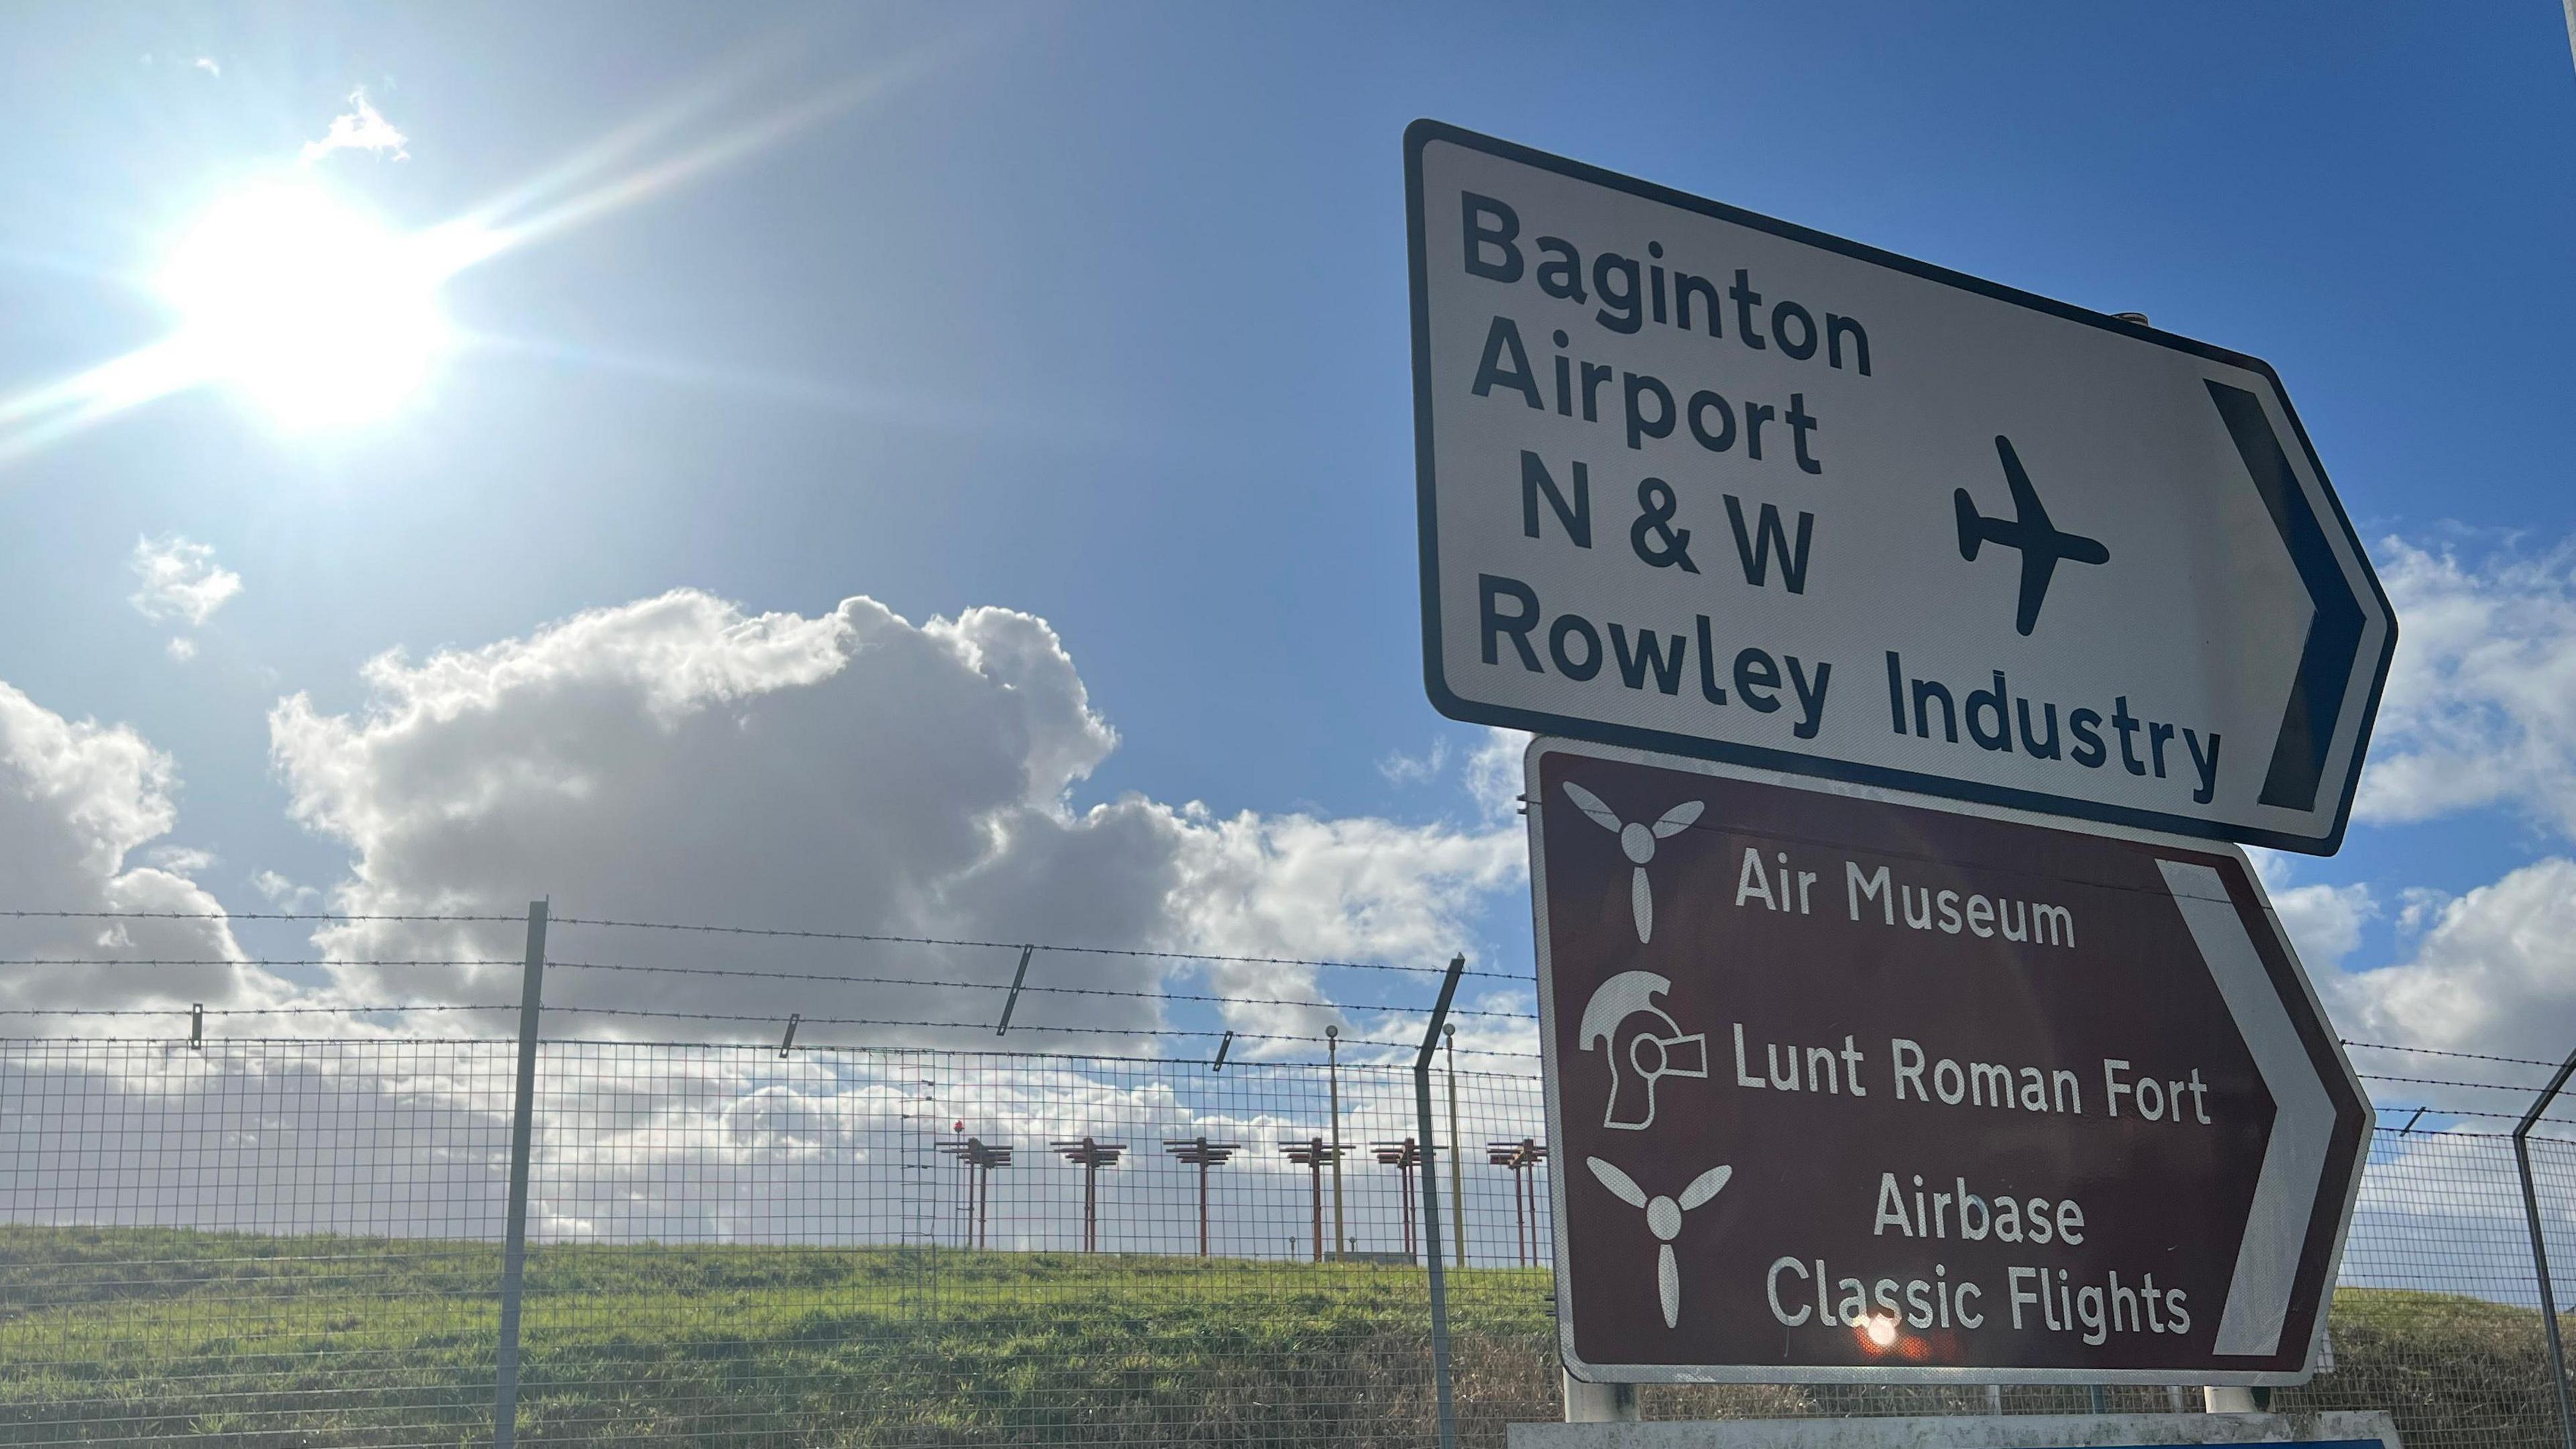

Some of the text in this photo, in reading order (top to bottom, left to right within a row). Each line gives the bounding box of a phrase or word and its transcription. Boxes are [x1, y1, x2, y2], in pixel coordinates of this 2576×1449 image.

[1461, 191, 1872, 376] Baginton
[1471, 315, 1822, 474] Airport
[1520, 449, 1814, 595] N & W
[1479, 573, 2221, 804] Rowley Industry
[1735, 847, 2076, 949] Air Museum
[1733, 1022, 2211, 1125] Lunt Roman Fort
[1874, 1172, 2085, 1245] Airbase
[1767, 1256, 2190, 1346] Classic Flights
